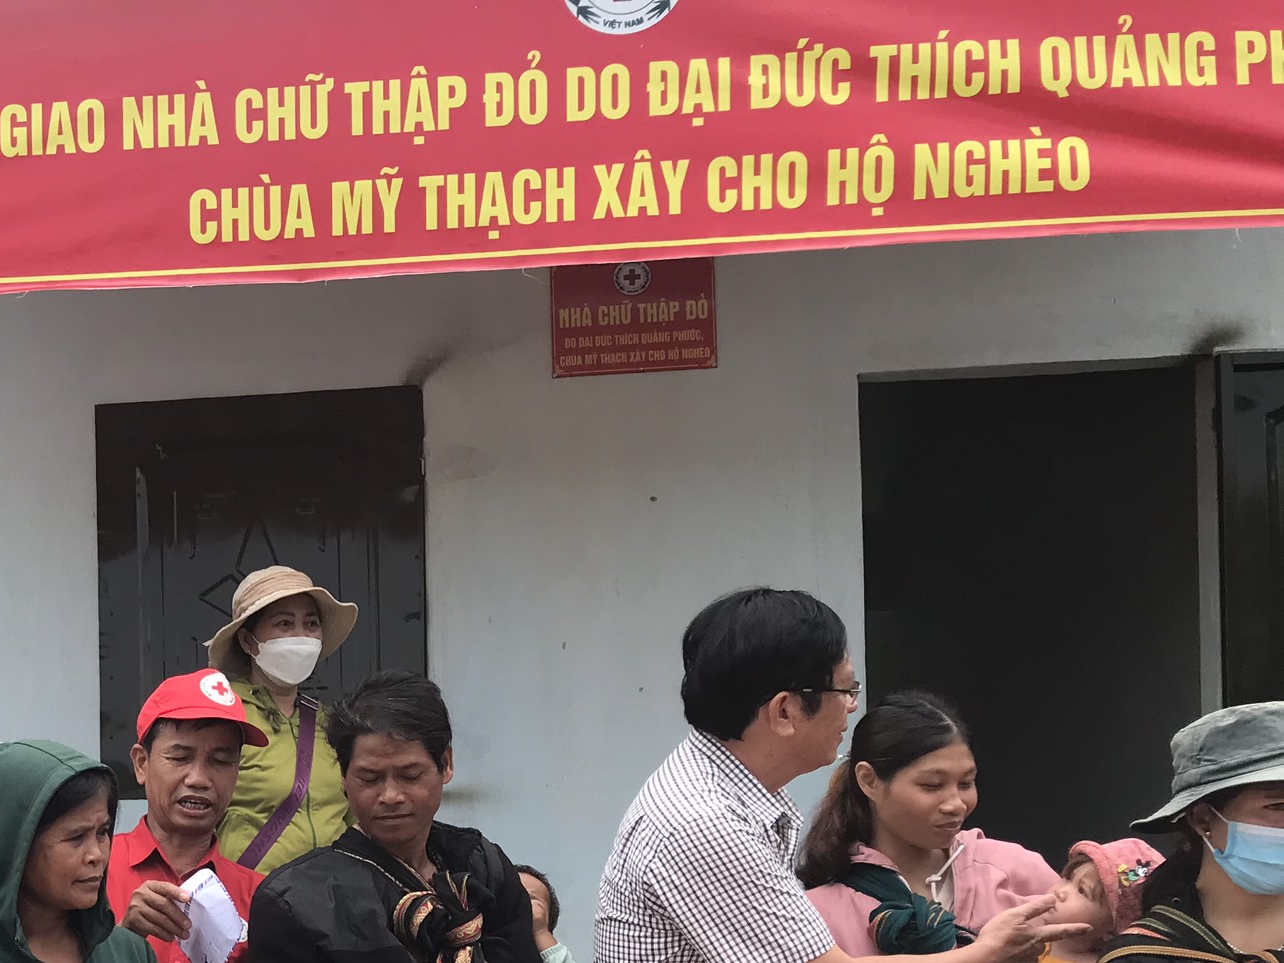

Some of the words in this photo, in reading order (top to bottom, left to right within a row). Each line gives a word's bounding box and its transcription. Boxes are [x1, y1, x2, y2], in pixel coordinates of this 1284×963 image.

[603, 19, 622, 30] VIỆT
[624, 16, 644, 28] NAM
[0, 98, 105, 157] GIAO
[122, 80, 219, 150] NHÀ
[235, 73, 334, 144] CHỮ
[344, 65, 467, 145] THẬP
[483, 50, 548, 127] ĐỎ
[566, 63, 630, 122] DO
[646, 57, 731, 127] ĐẠI
[748, 38, 851, 111] ĐỨC
[869, 30, 1021, 102] THÍCH
[1039, 15, 1217, 98] QUẢNG
[189, 174, 315, 244] CHÙA
[331, 167, 403, 236] MỸ
[419, 169, 576, 240] THẠCH
[593, 149, 689, 219] XÂY
[707, 151, 808, 213] CHO
[826, 134, 895, 216] HỘ
[913, 127, 1090, 200] NGHÈO
[559, 303, 592, 328] NHÀ
[598, 300, 632, 325] CHỮ
[637, 298, 680, 326] THẬP
[685, 293, 708, 321] ĐỎ
[565, 338, 576, 348] DO
[600, 352, 627, 365] THẠCH
[648, 349, 666, 361] CHO
[668, 348, 680, 360] HỘ
